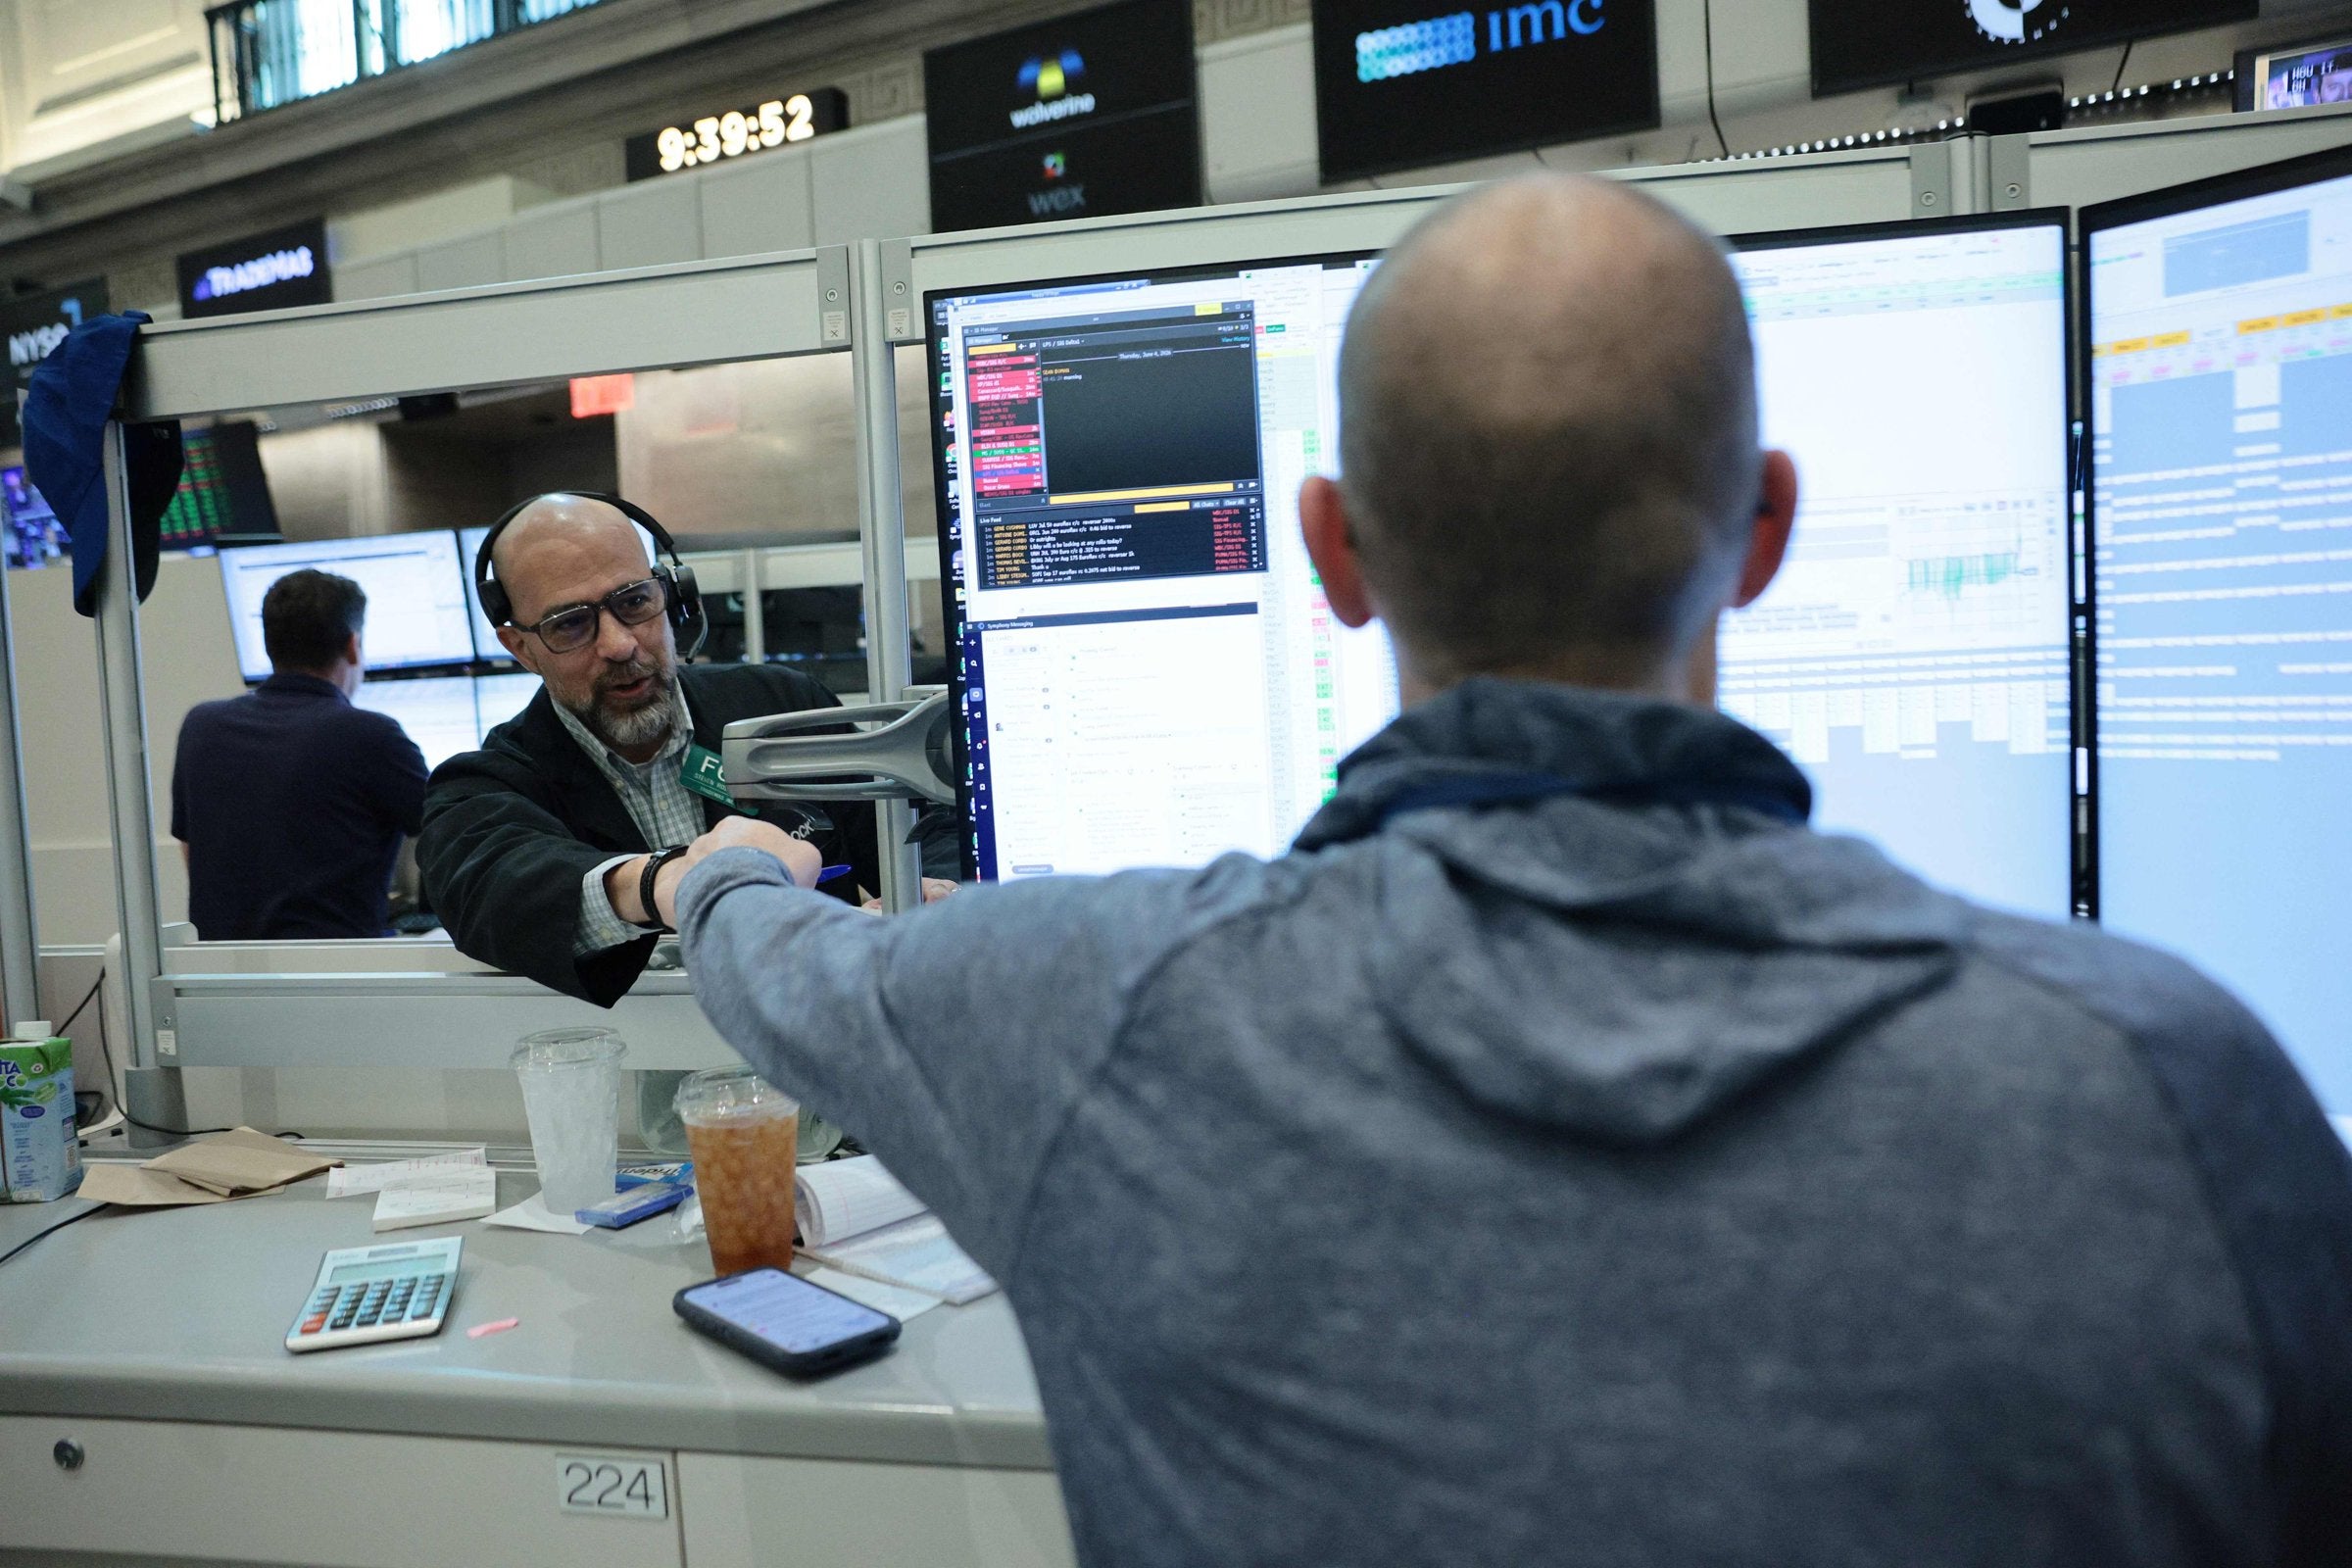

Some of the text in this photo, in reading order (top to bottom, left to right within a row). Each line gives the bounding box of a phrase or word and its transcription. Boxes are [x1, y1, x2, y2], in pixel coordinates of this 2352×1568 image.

[657, 94, 814, 172] 9:39:52
[1009, 93, 1096, 128] wolverine
[564, 1462, 656, 1510] 224
